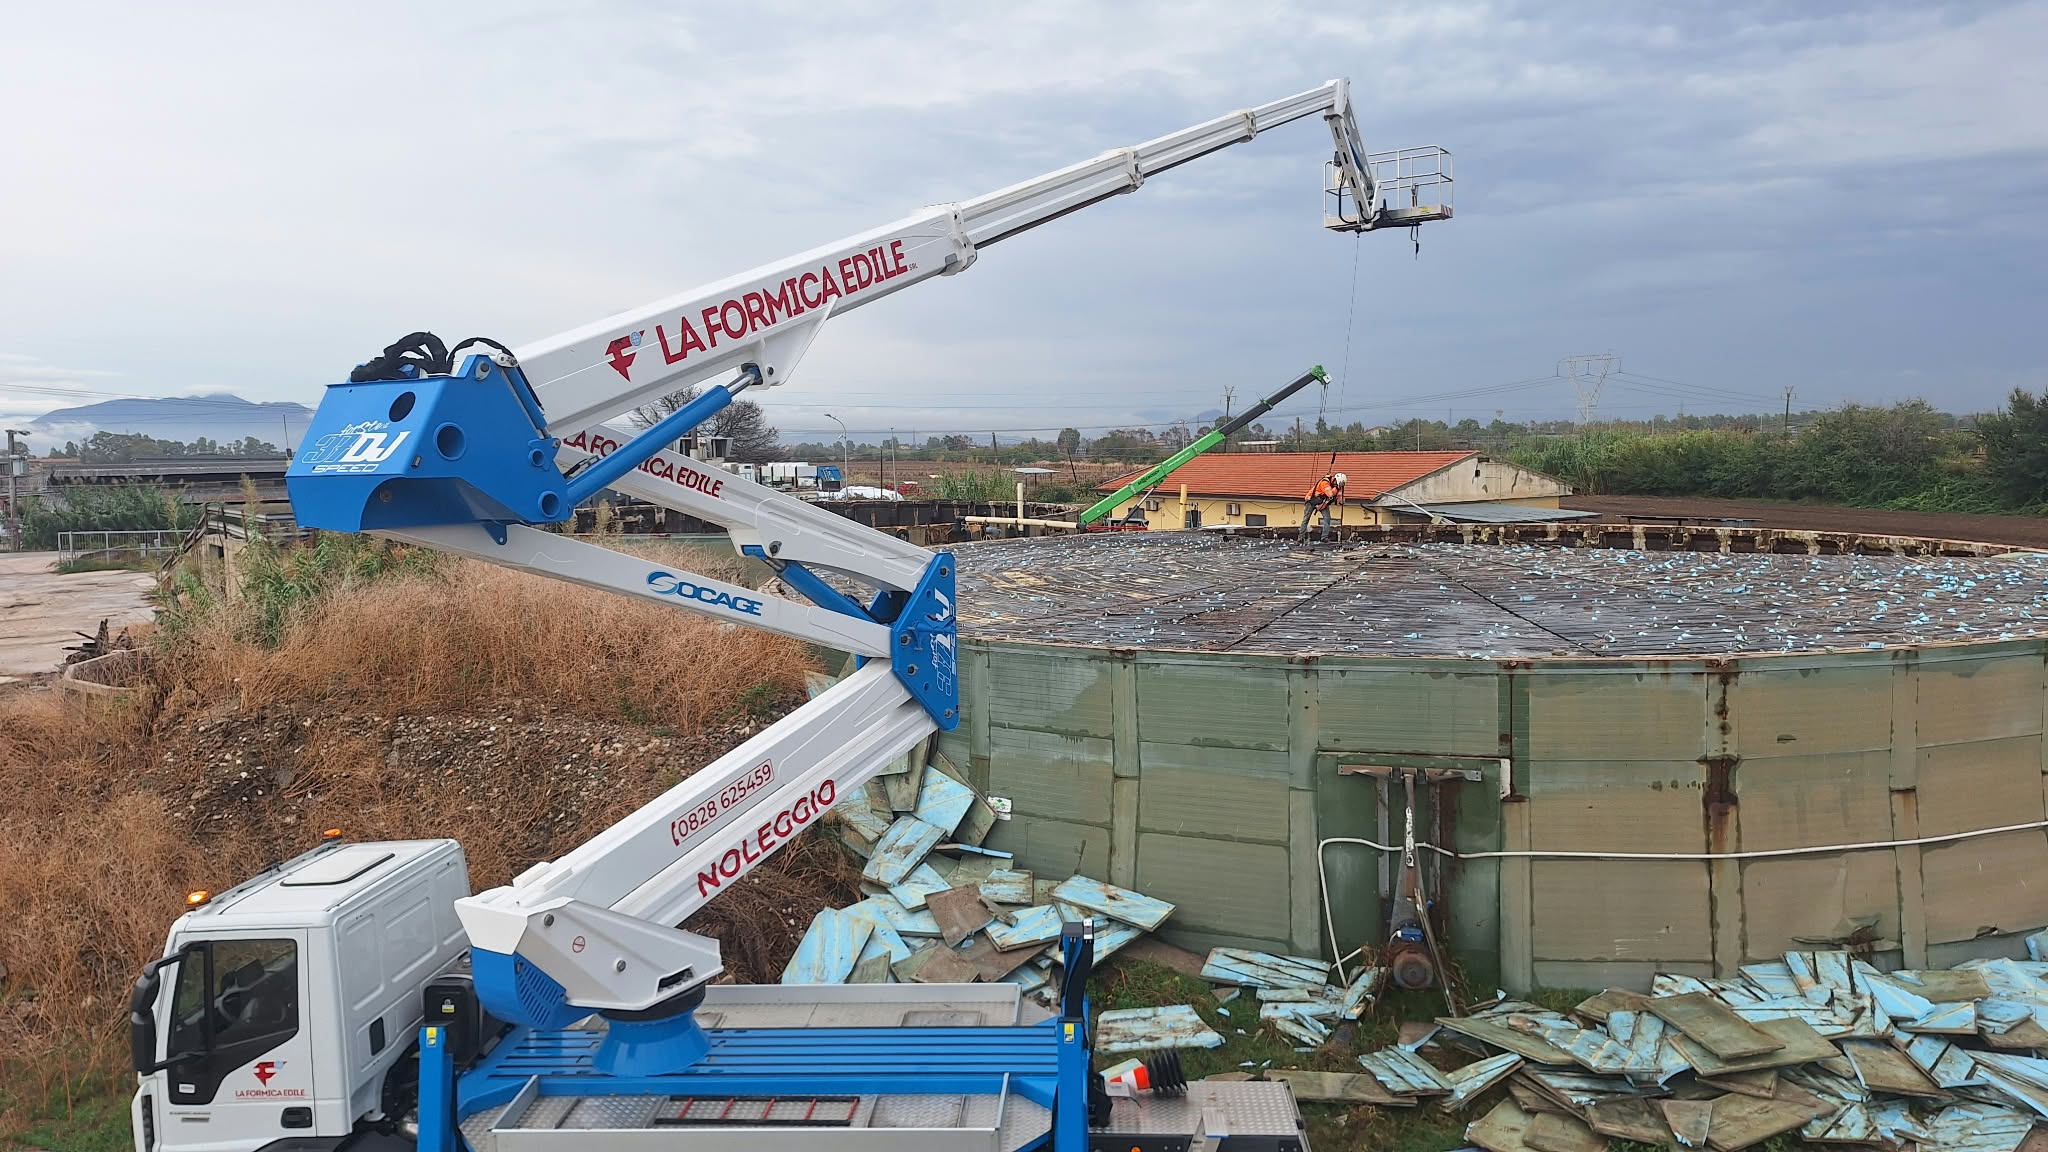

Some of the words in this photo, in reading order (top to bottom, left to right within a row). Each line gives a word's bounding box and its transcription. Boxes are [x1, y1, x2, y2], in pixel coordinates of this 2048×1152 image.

[655, 316, 706, 366] LA
[701, 266, 842, 347] FORMICA
[838, 240, 909, 295] EDILE
[312, 463, 380, 473] SPEED
[590, 434, 675, 482] FOICA
[676, 466, 724, 498] EDILE
[646, 571, 763, 616] SOCAGE
[678, 800, 718, 837] 0828
[720, 764, 772, 809] 625459
[697, 779, 836, 898] NOLEGGIO
[235, 1089, 245, 1097] LA
[246, 1089, 283, 1097] FORMICA
[284, 1088, 305, 1097] EDILE
